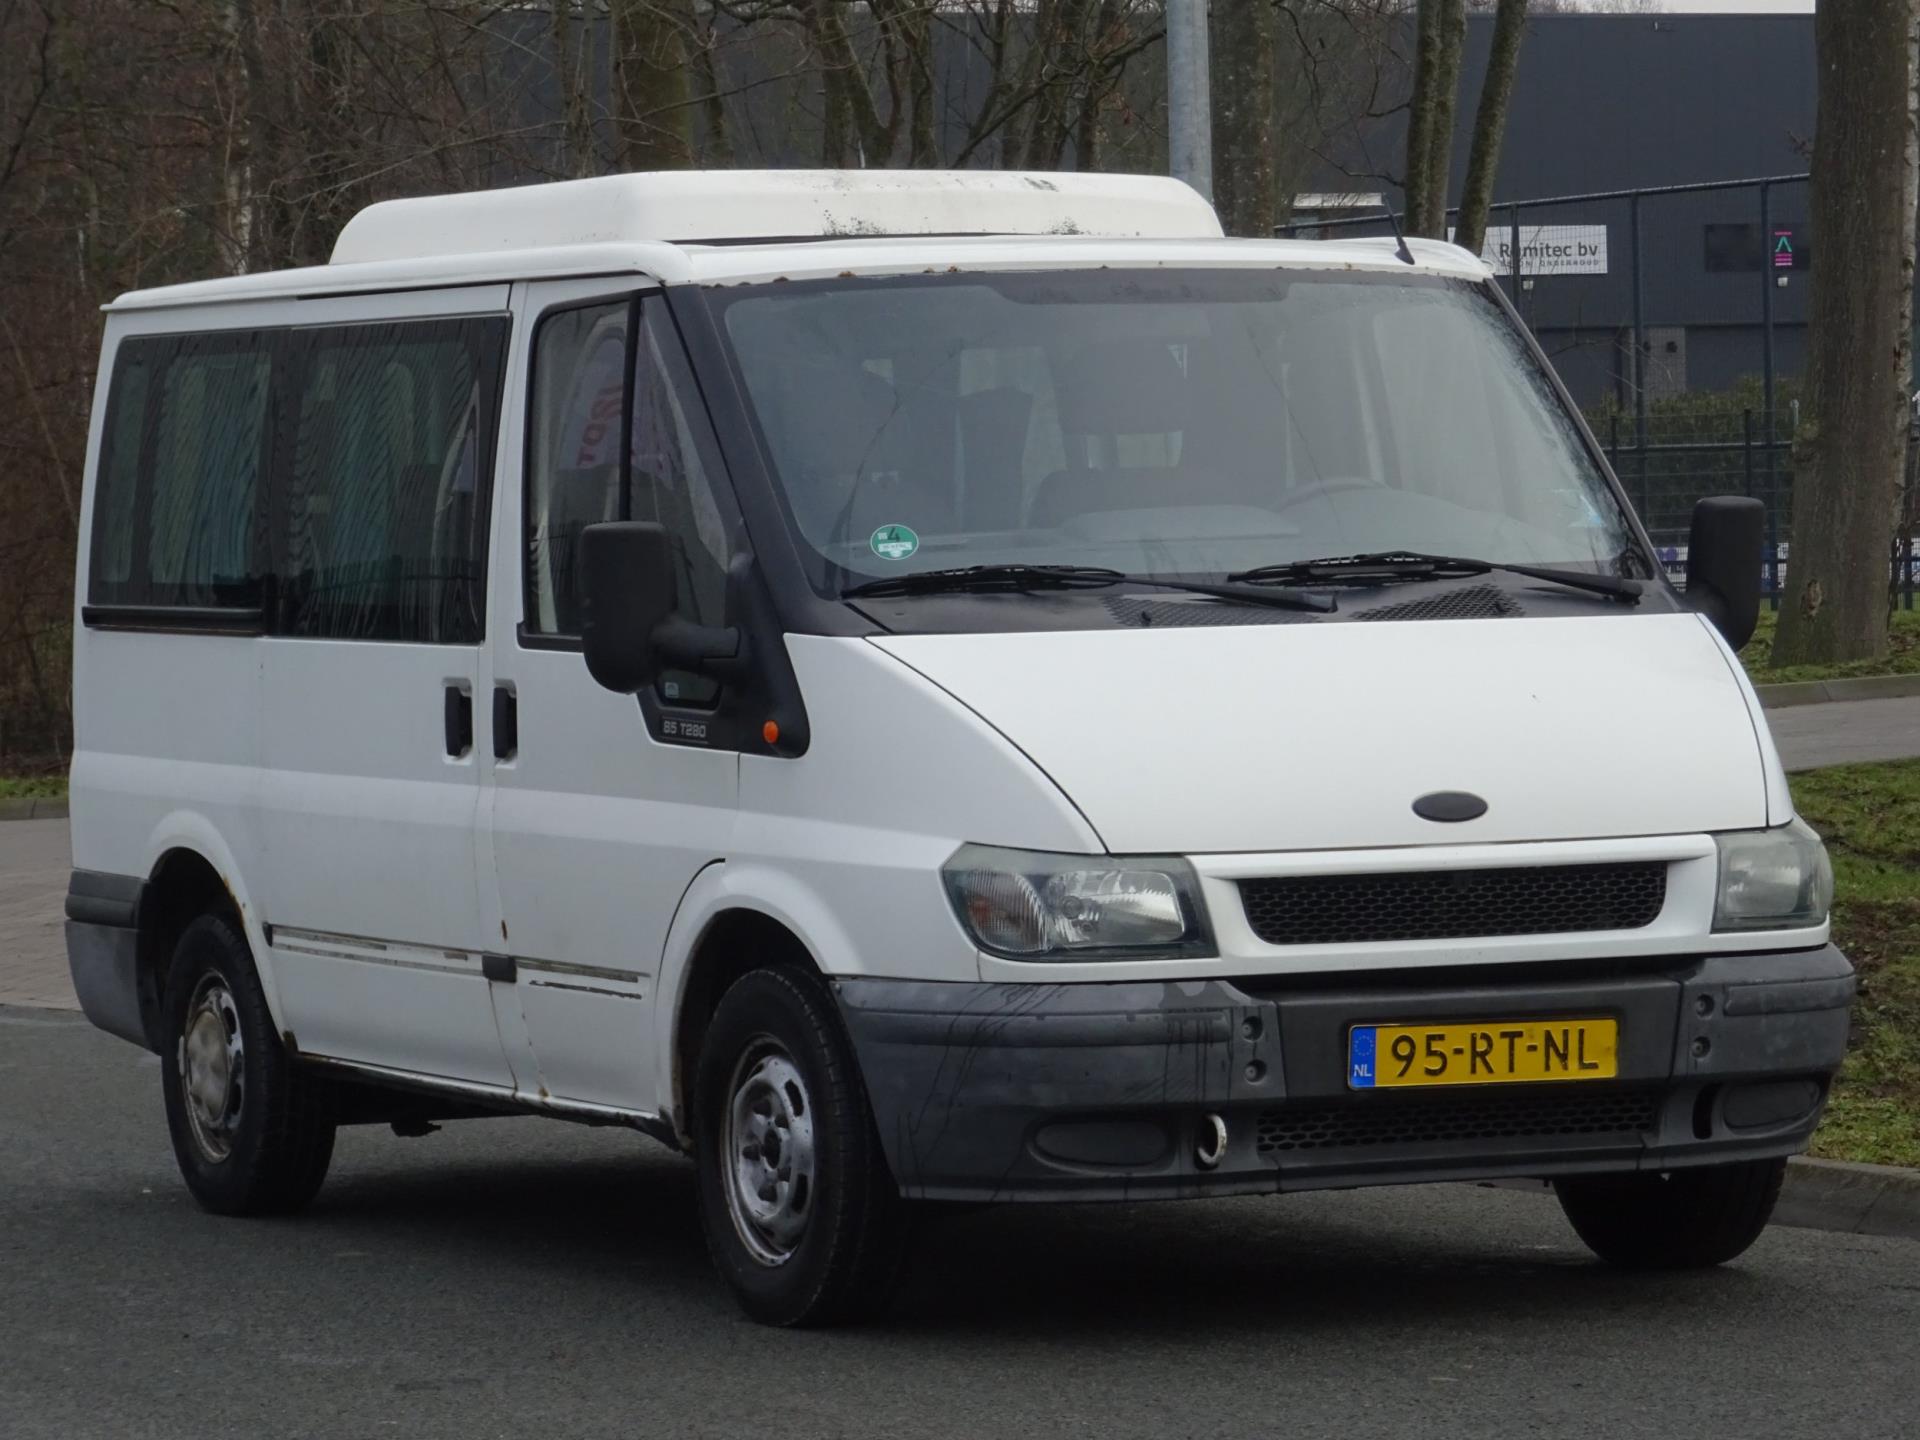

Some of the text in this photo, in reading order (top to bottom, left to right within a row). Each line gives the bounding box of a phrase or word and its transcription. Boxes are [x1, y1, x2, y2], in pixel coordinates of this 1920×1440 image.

[1500, 242, 1598, 258] Rmitec bv
[888, 527, 900, 541] 4
[664, 720, 706, 738] 85 T280
[1391, 1028, 1599, 1078] 95-RT-NL
[1354, 1064, 1372, 1077] NL
